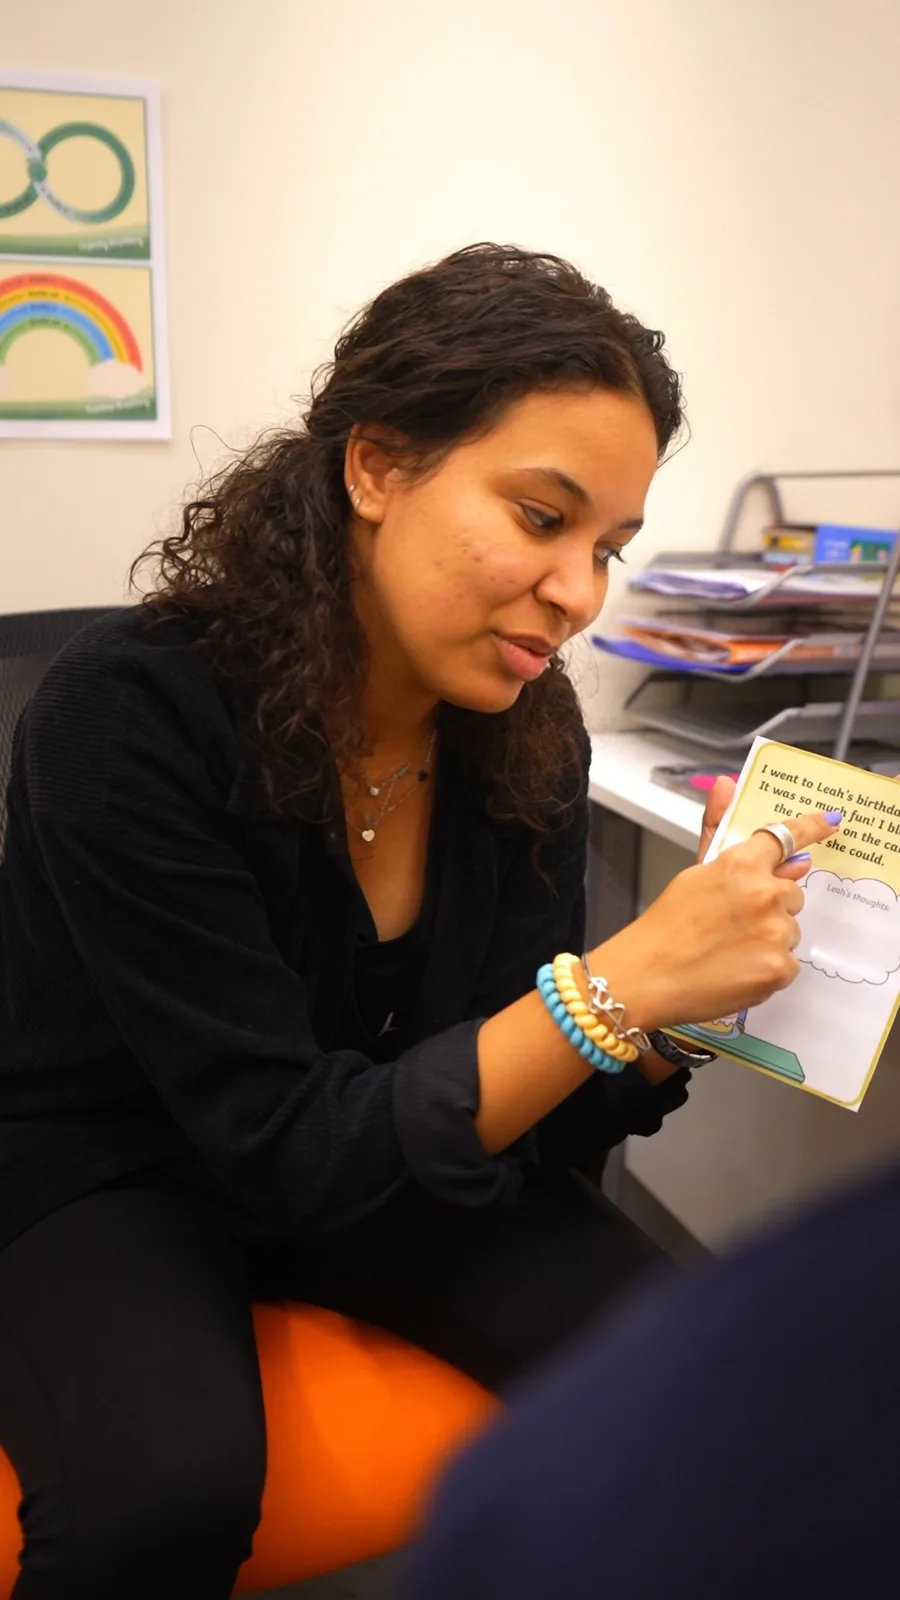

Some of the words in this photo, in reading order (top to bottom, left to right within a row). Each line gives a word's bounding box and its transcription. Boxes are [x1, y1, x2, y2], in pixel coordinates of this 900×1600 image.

[761, 764, 768, 774] I
[770, 769, 799, 784] went
[802, 778, 814, 788] to
[817, 782, 854, 802] Leah's
[759, 780, 770, 792] It
[773, 787, 796, 800] was
[799, 796, 812, 805] so
[848, 810, 876, 826] fun!
[878, 819, 885, 830] I
[774, 803, 793, 817] the
[843, 828, 858, 839] on
[861, 832, 881, 846] the
[825, 838, 846, 852] she
[849, 848, 885, 866] could.
[827, 884, 851, 898] Leah's
